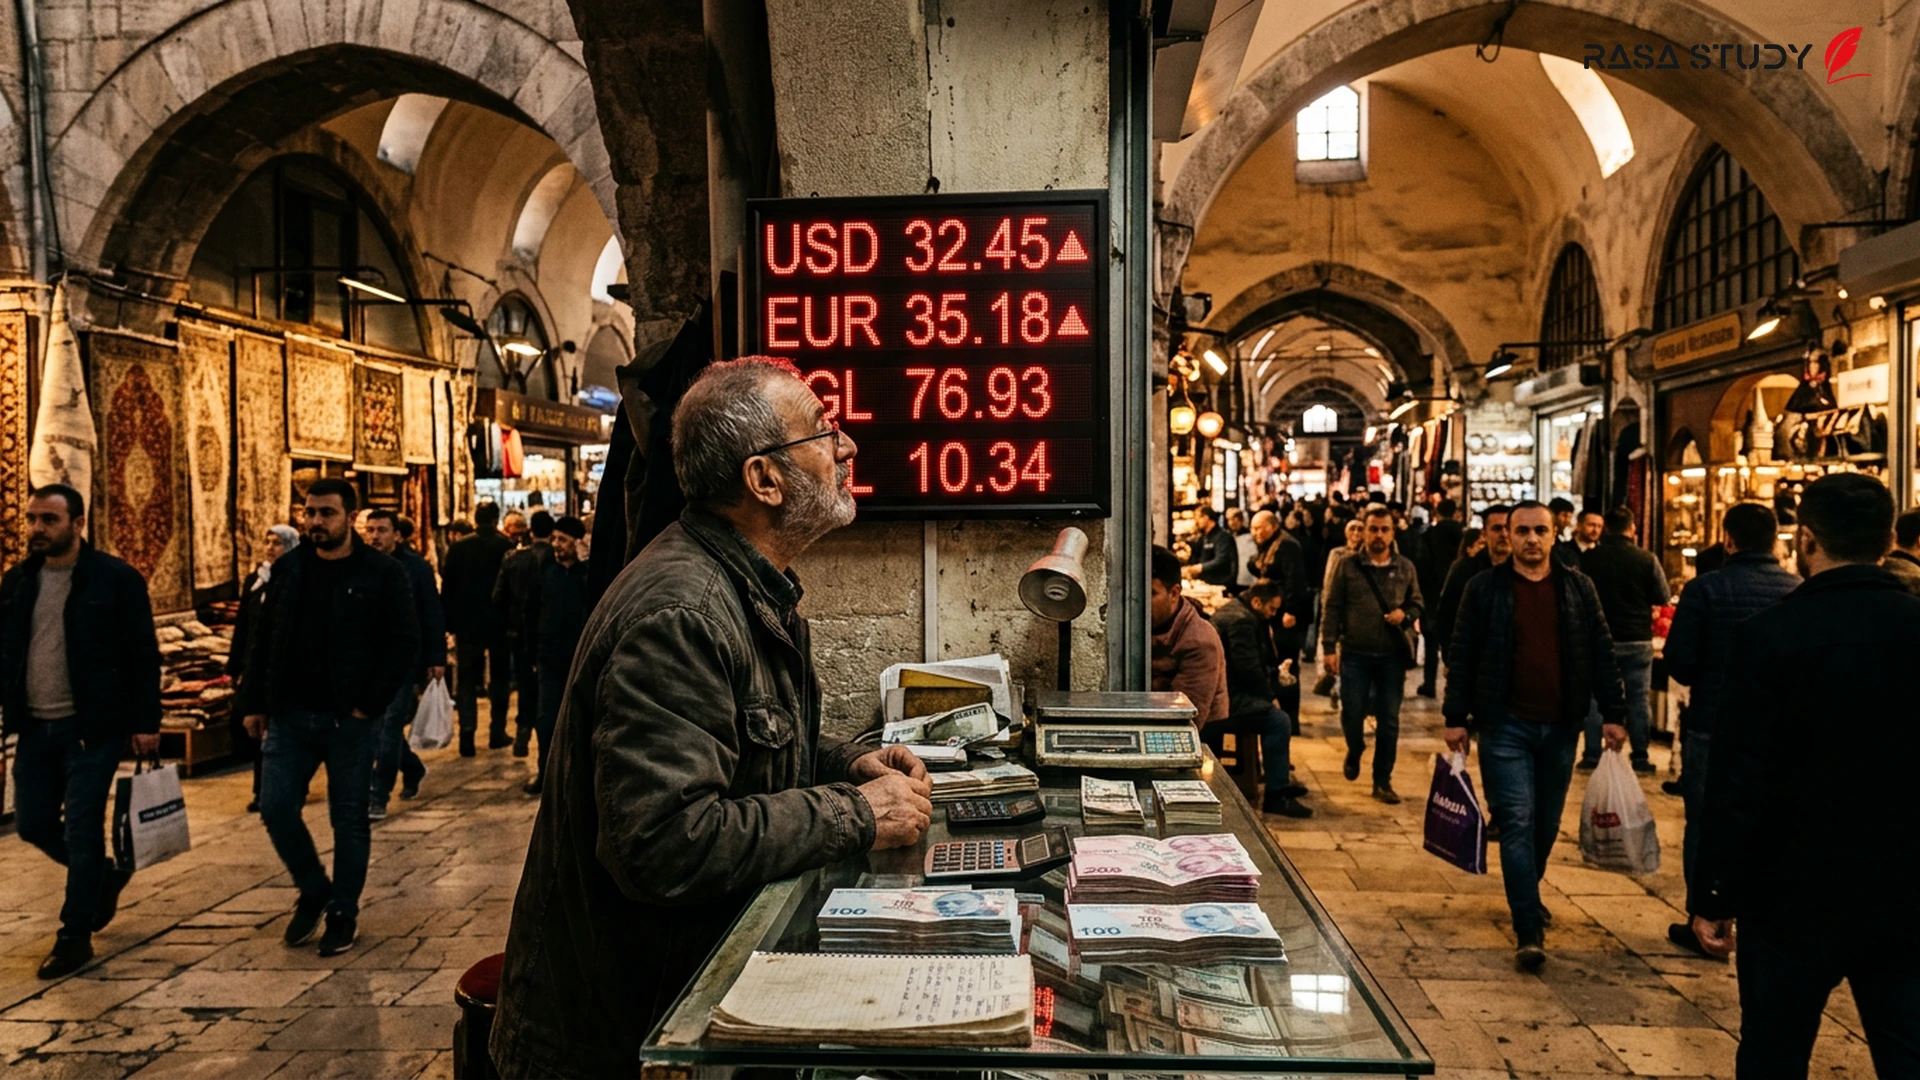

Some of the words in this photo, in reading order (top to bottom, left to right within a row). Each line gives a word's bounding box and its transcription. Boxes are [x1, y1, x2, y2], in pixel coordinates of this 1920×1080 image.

[767, 222, 878, 274] USD
[906, 217, 1049, 271] 32.45
[768, 295, 880, 348] EUR
[906, 292, 1050, 345] 35.18
[804, 370, 872, 422] GL
[906, 367, 1051, 419] 76.93
[910, 441, 1051, 492] 10.34
